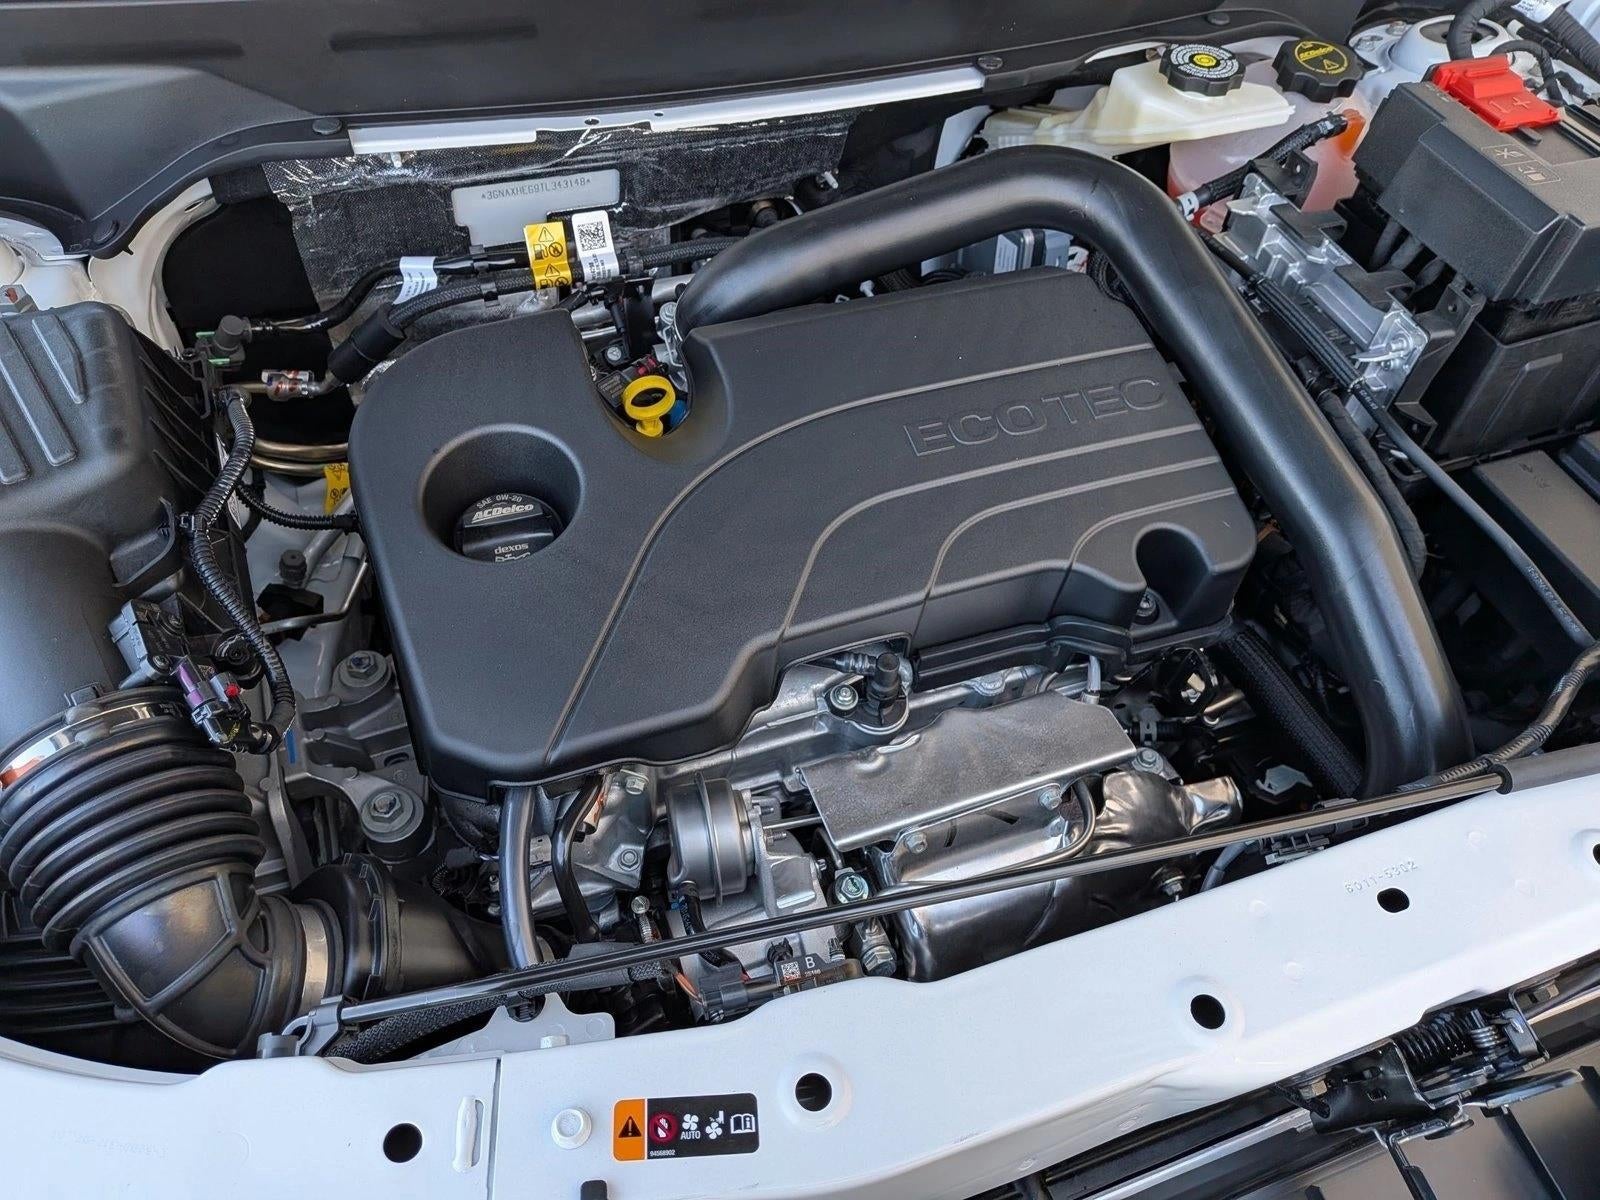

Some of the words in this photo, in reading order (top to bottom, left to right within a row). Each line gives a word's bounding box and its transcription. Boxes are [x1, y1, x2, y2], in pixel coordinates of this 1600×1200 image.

[904, 376, 1168, 457] ECOTEC
[476, 497, 493, 509] SAE
[495, 494, 523, 503] 0W-20
[471, 503, 534, 522] ACDelco
[494, 542, 529, 555] dexos
[804, 956, 816, 969] B
[680, 1130, 701, 1140] AUTO
